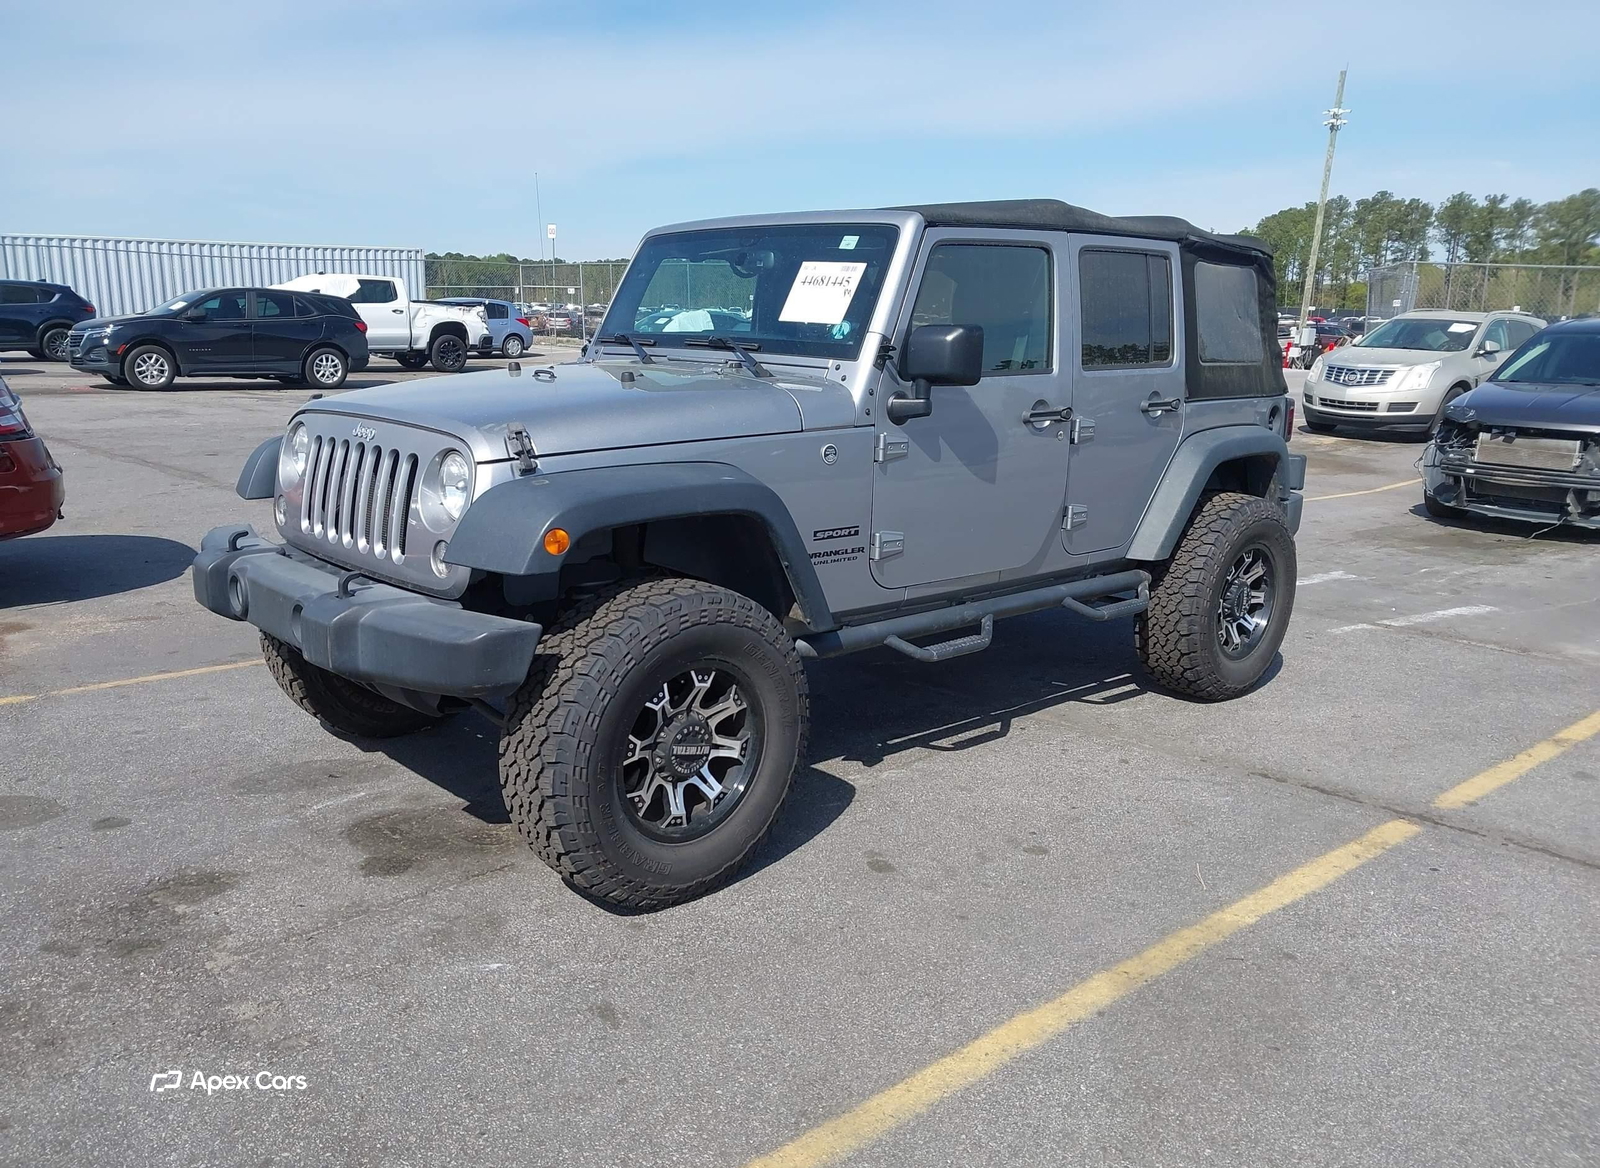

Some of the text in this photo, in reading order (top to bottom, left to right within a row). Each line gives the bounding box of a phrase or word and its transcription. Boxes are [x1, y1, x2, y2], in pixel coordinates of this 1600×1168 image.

[801, 275, 852, 288] 44681445
[352, 421, 377, 442] Jeep
[814, 528, 858, 540] SPORT
[813, 556, 858, 566] UNLIMITED
